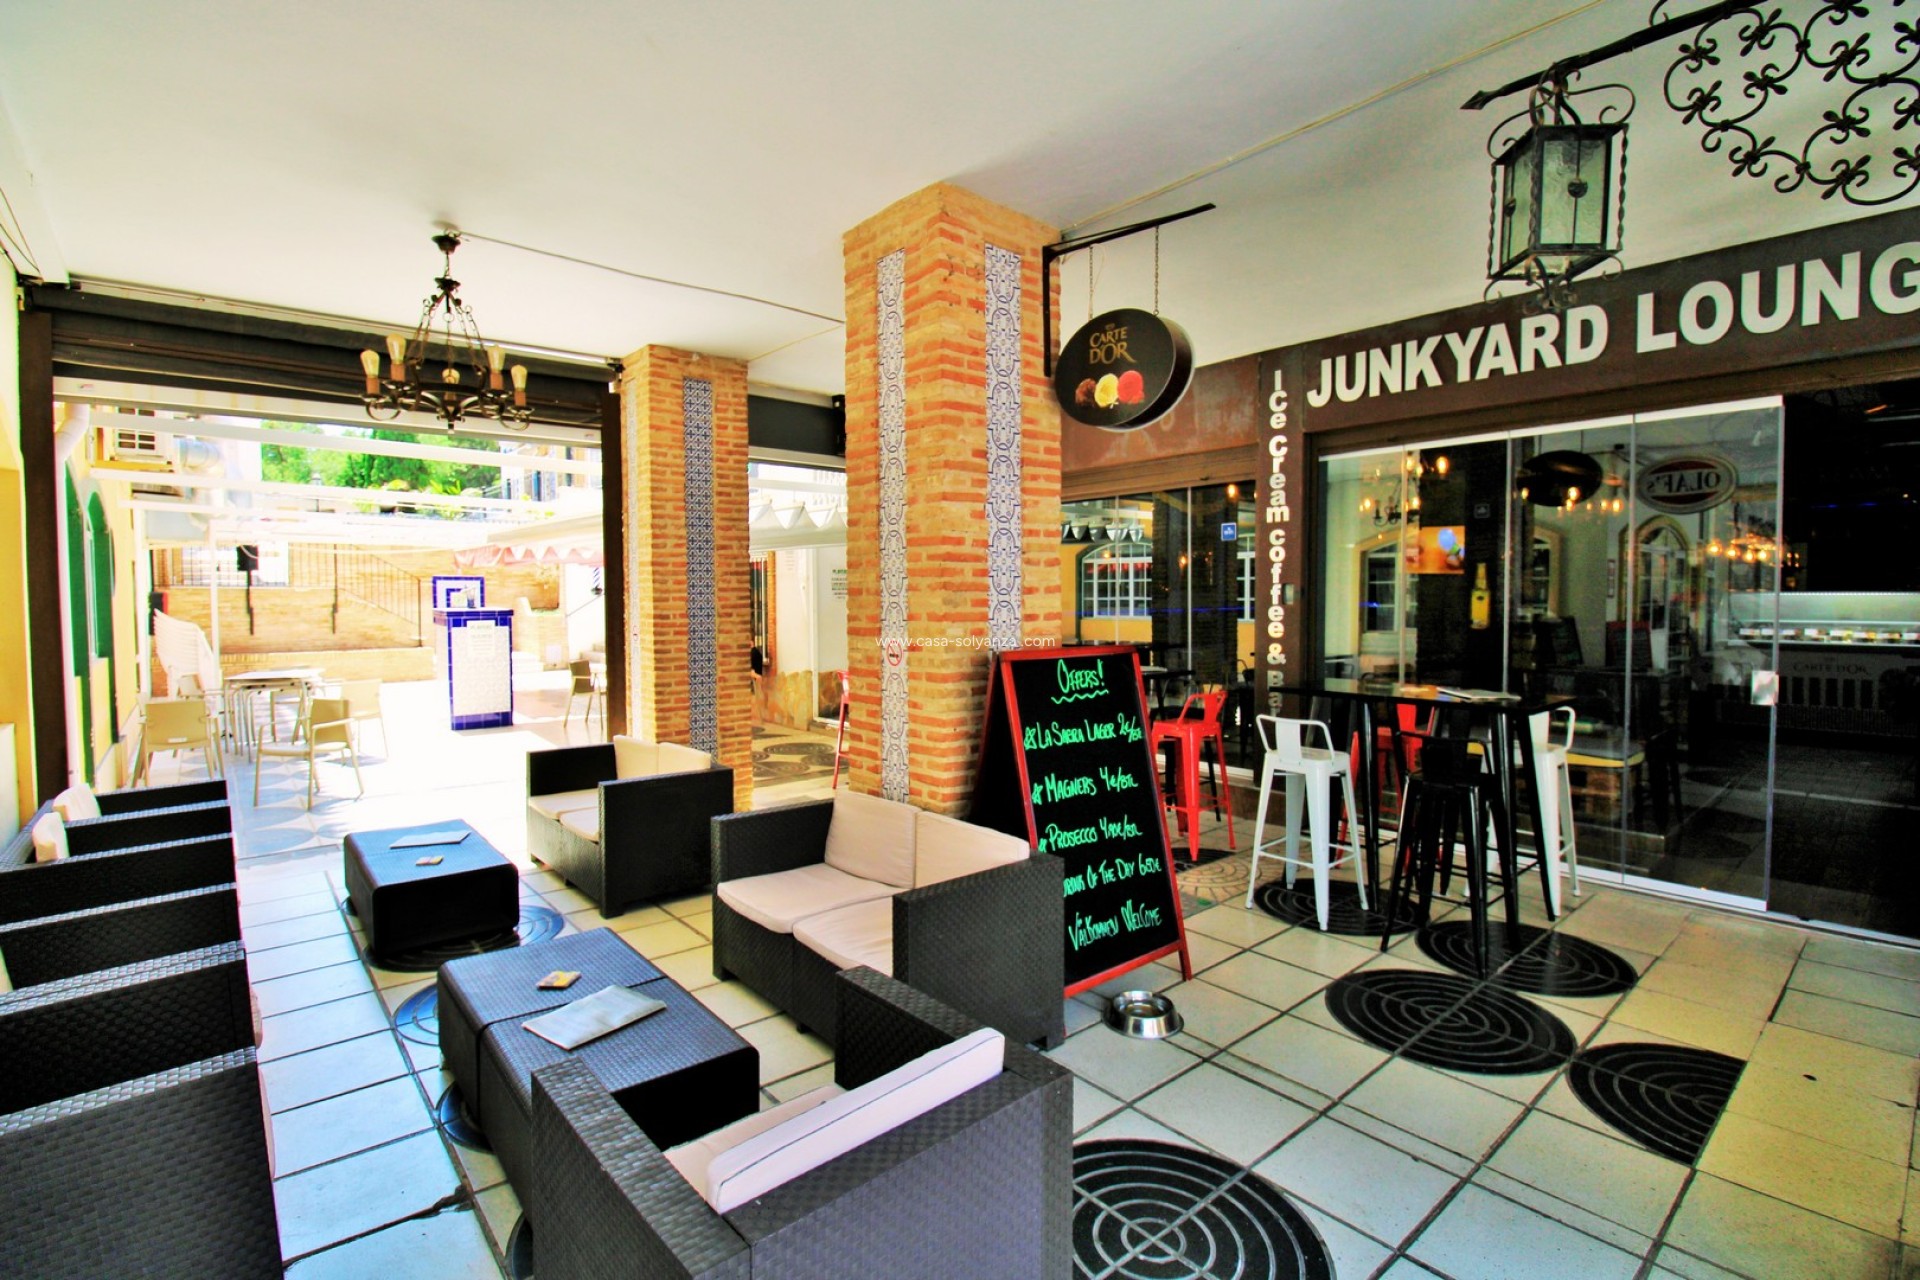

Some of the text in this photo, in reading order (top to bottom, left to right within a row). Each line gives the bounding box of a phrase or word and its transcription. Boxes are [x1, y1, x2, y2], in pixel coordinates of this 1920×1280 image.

[1089, 327, 1128, 348] CARTE
[1306, 304, 1609, 408] JUNKYARD
[1266, 435, 1290, 523] Cream
[1267, 643, 1287, 665] &
[1045, 823, 1098, 851] PROSECCO
